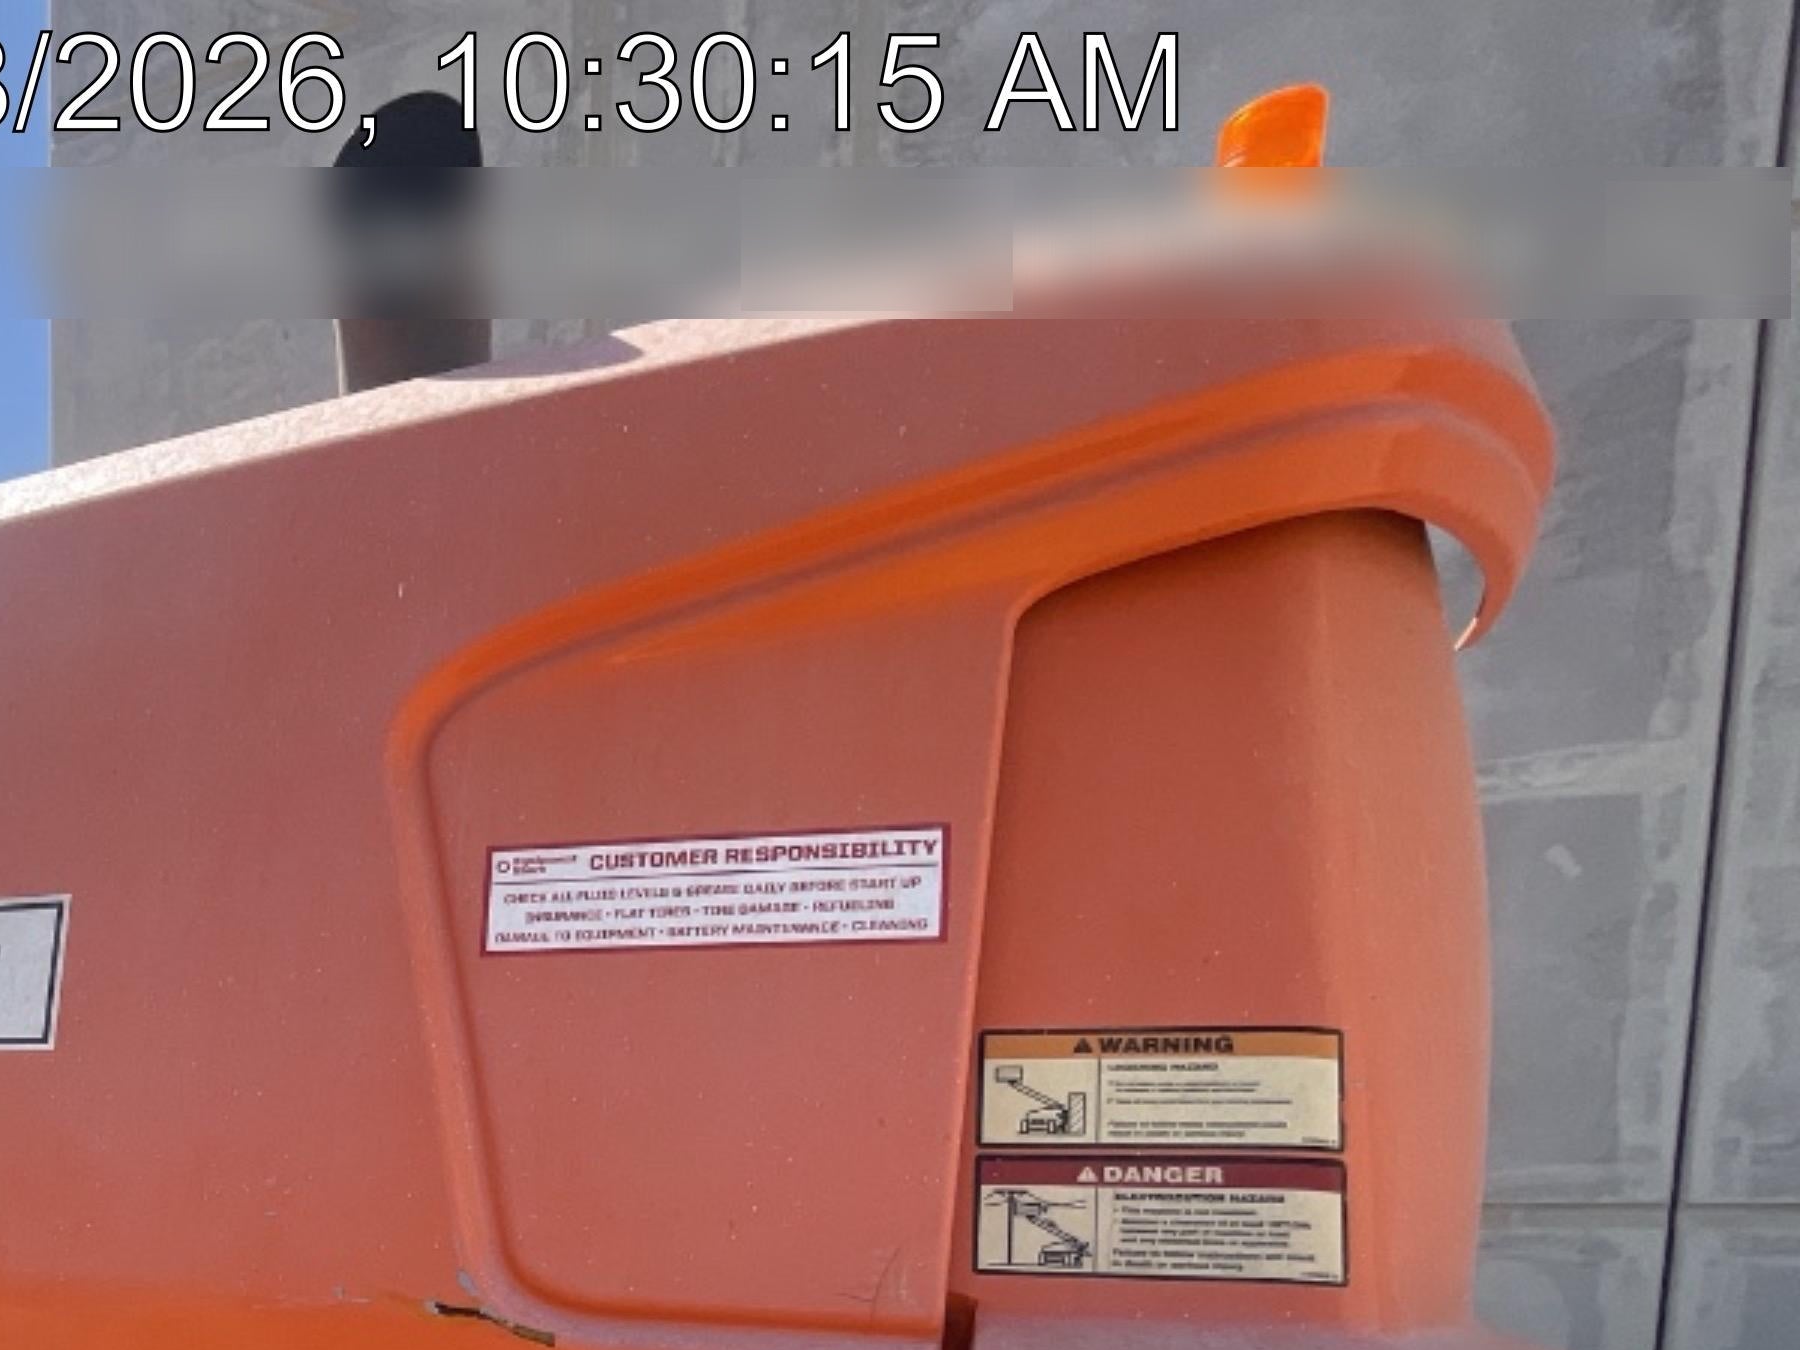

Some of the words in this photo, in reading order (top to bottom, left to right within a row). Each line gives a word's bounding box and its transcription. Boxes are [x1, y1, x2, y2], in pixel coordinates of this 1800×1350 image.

[589, 848, 718, 871] CUSTOMER
[725, 838, 938, 864] RESPONSIBILITY
[743, 881, 786, 895] DAILY
[1098, 1036, 1235, 1054] WARNING
[1103, 1166, 1224, 1184] DANGER
